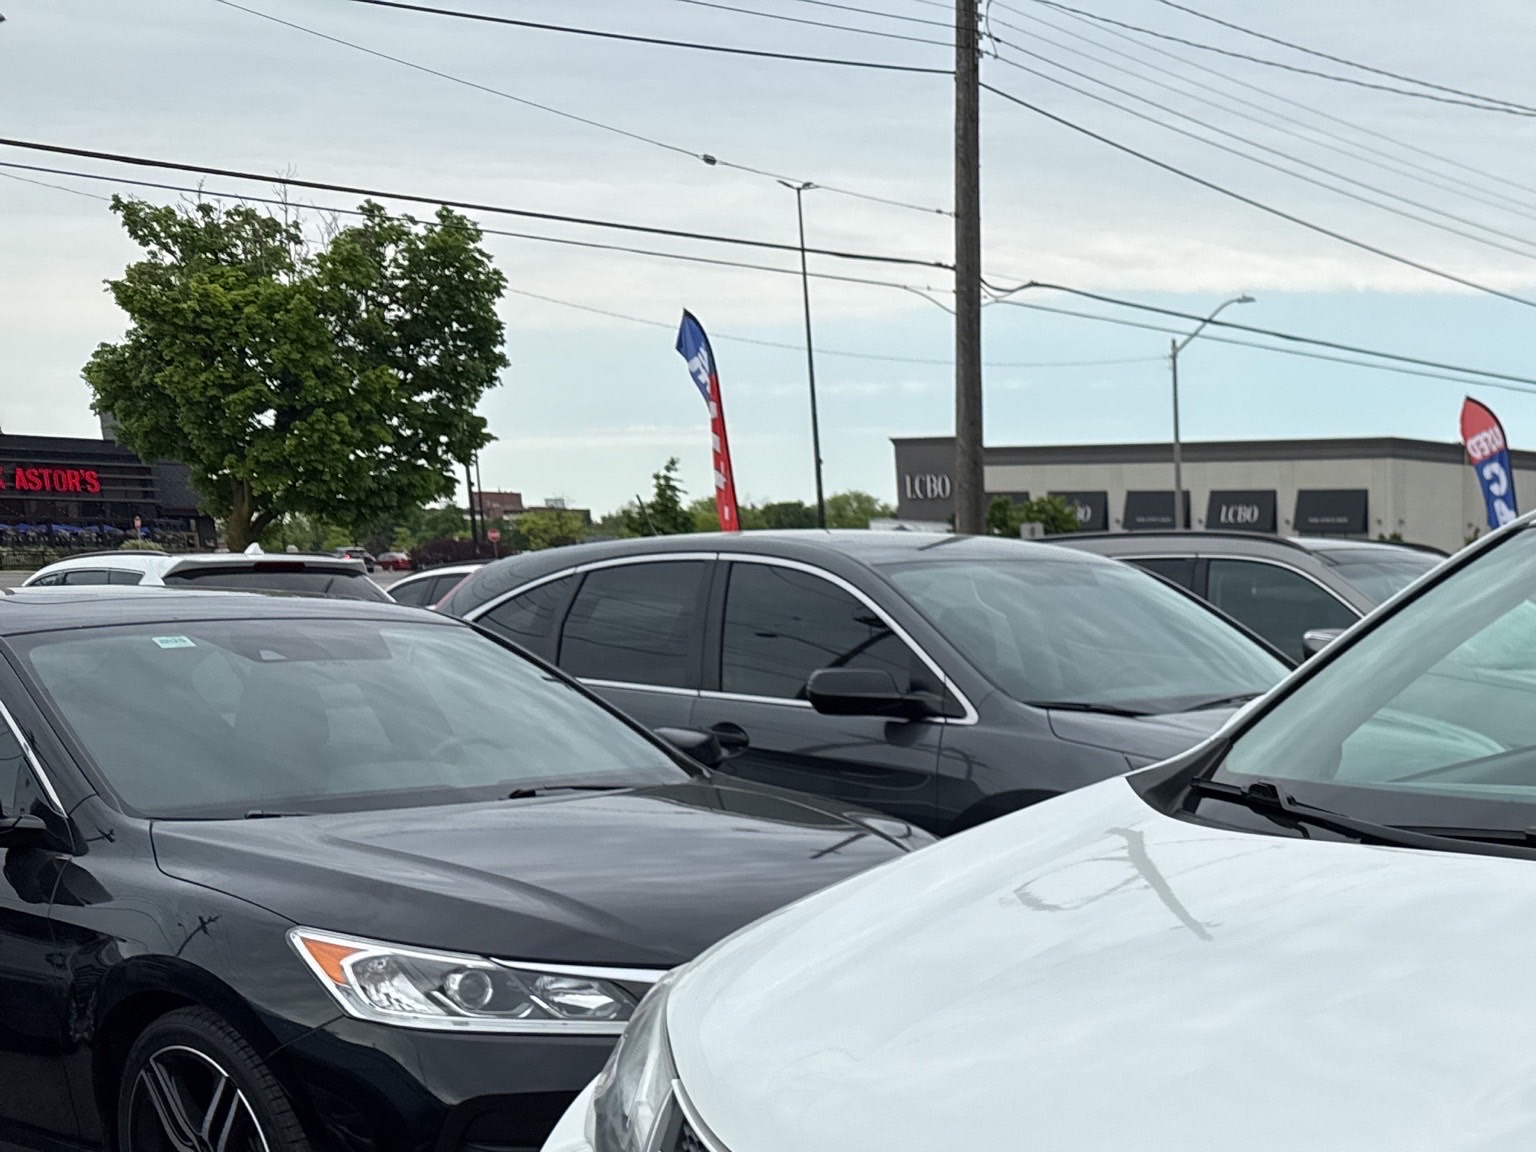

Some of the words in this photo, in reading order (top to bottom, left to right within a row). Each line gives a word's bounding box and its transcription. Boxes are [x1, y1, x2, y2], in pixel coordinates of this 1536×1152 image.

[15, 467, 101, 494] ASTOR'S
[904, 473, 951, 499] LCBO
[1219, 504, 1260, 524] LCBO
